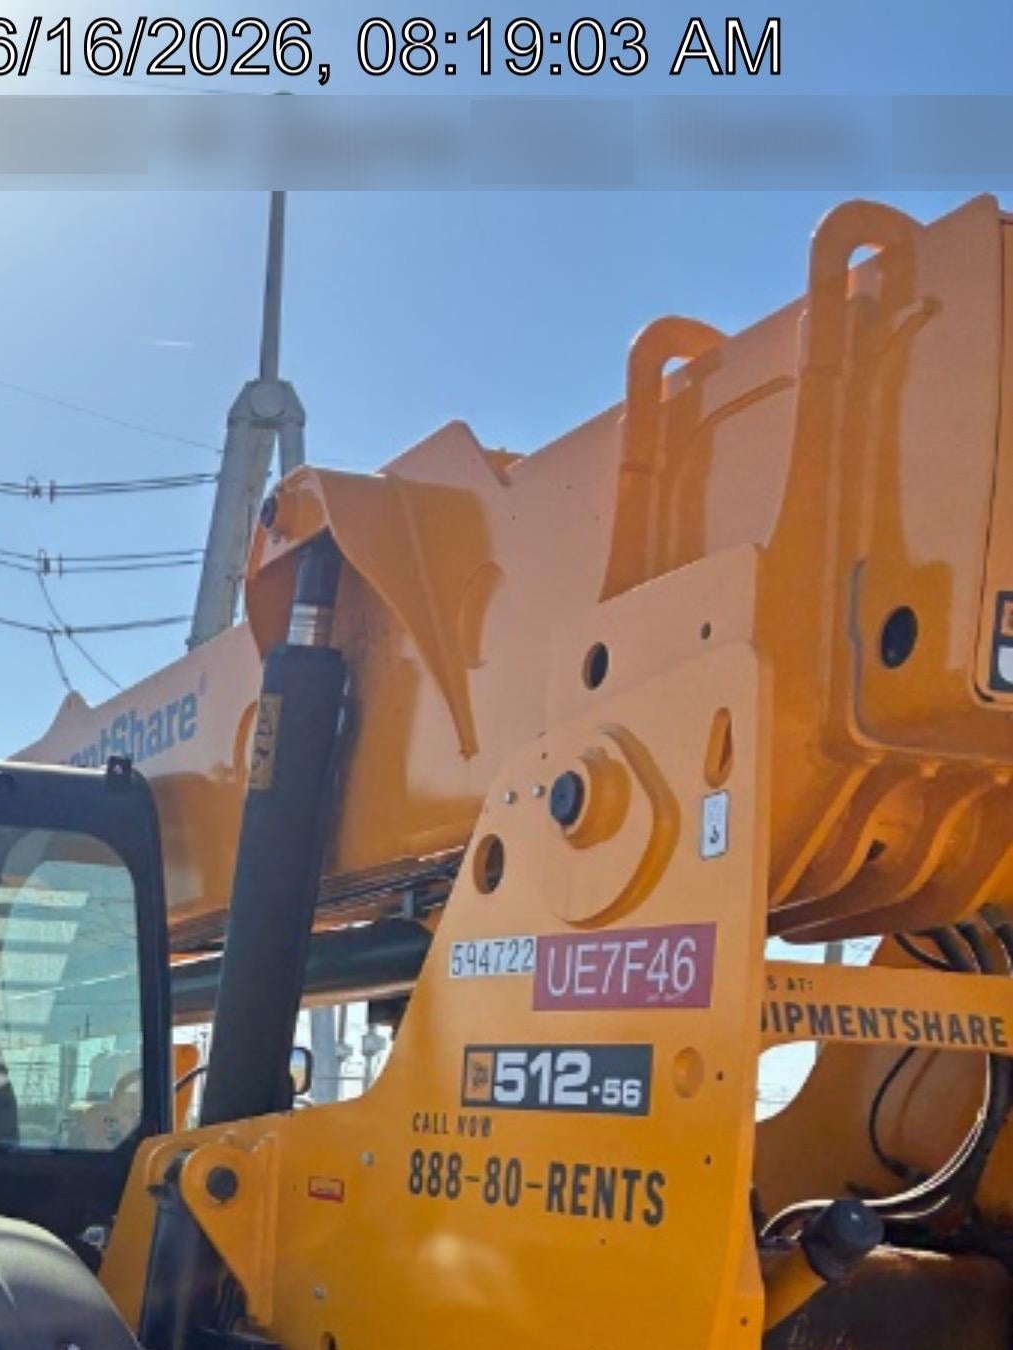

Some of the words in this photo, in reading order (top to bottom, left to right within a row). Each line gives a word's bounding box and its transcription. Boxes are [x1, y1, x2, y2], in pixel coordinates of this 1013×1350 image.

[451, 938, 534, 976] 594722
[547, 936, 697, 997] UE7F46
[787, 976, 814, 991] AT:
[412, 1112, 449, 1135] CALL
[457, 1115, 493, 1138] NOW
[408, 1148, 667, 1227] 888-80-RENTS
